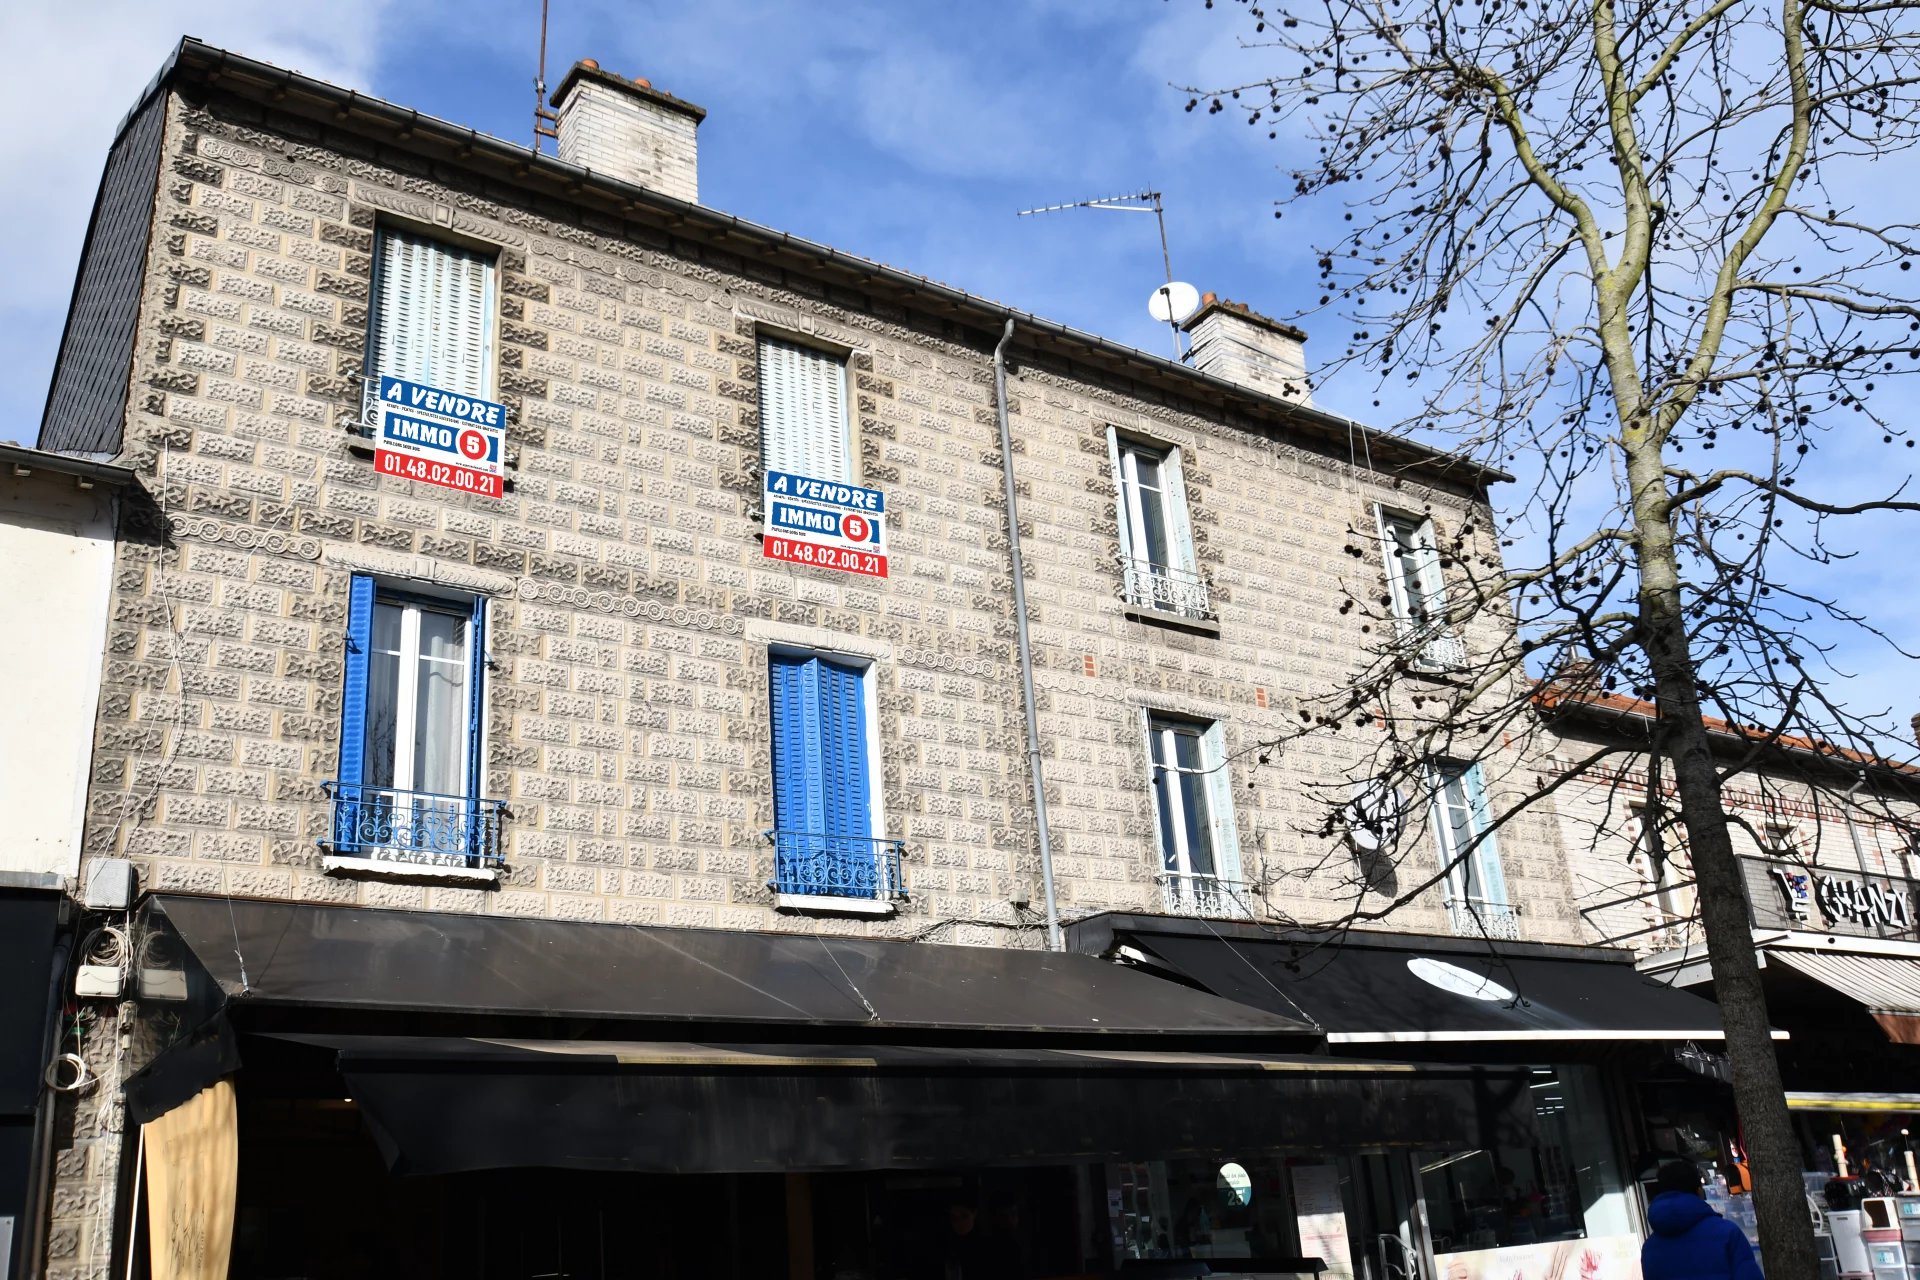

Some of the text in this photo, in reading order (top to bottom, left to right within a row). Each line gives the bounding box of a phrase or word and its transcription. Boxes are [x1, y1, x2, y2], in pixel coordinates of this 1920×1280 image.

[387, 382, 402, 401] A
[411, 386, 500, 425] VENDRE
[392, 418, 453, 448] IMMO
[466, 435, 480, 454] 5
[384, 454, 494, 494] 01.48.02.00.21
[773, 475, 787, 492] A
[796, 479, 878, 509] VENDRE
[779, 507, 836, 532] IMMO
[849, 519, 862, 536] 5
[773, 540, 879, 574] 01.48.02.00.21
[1820, 874, 1908, 927] CHANZY
